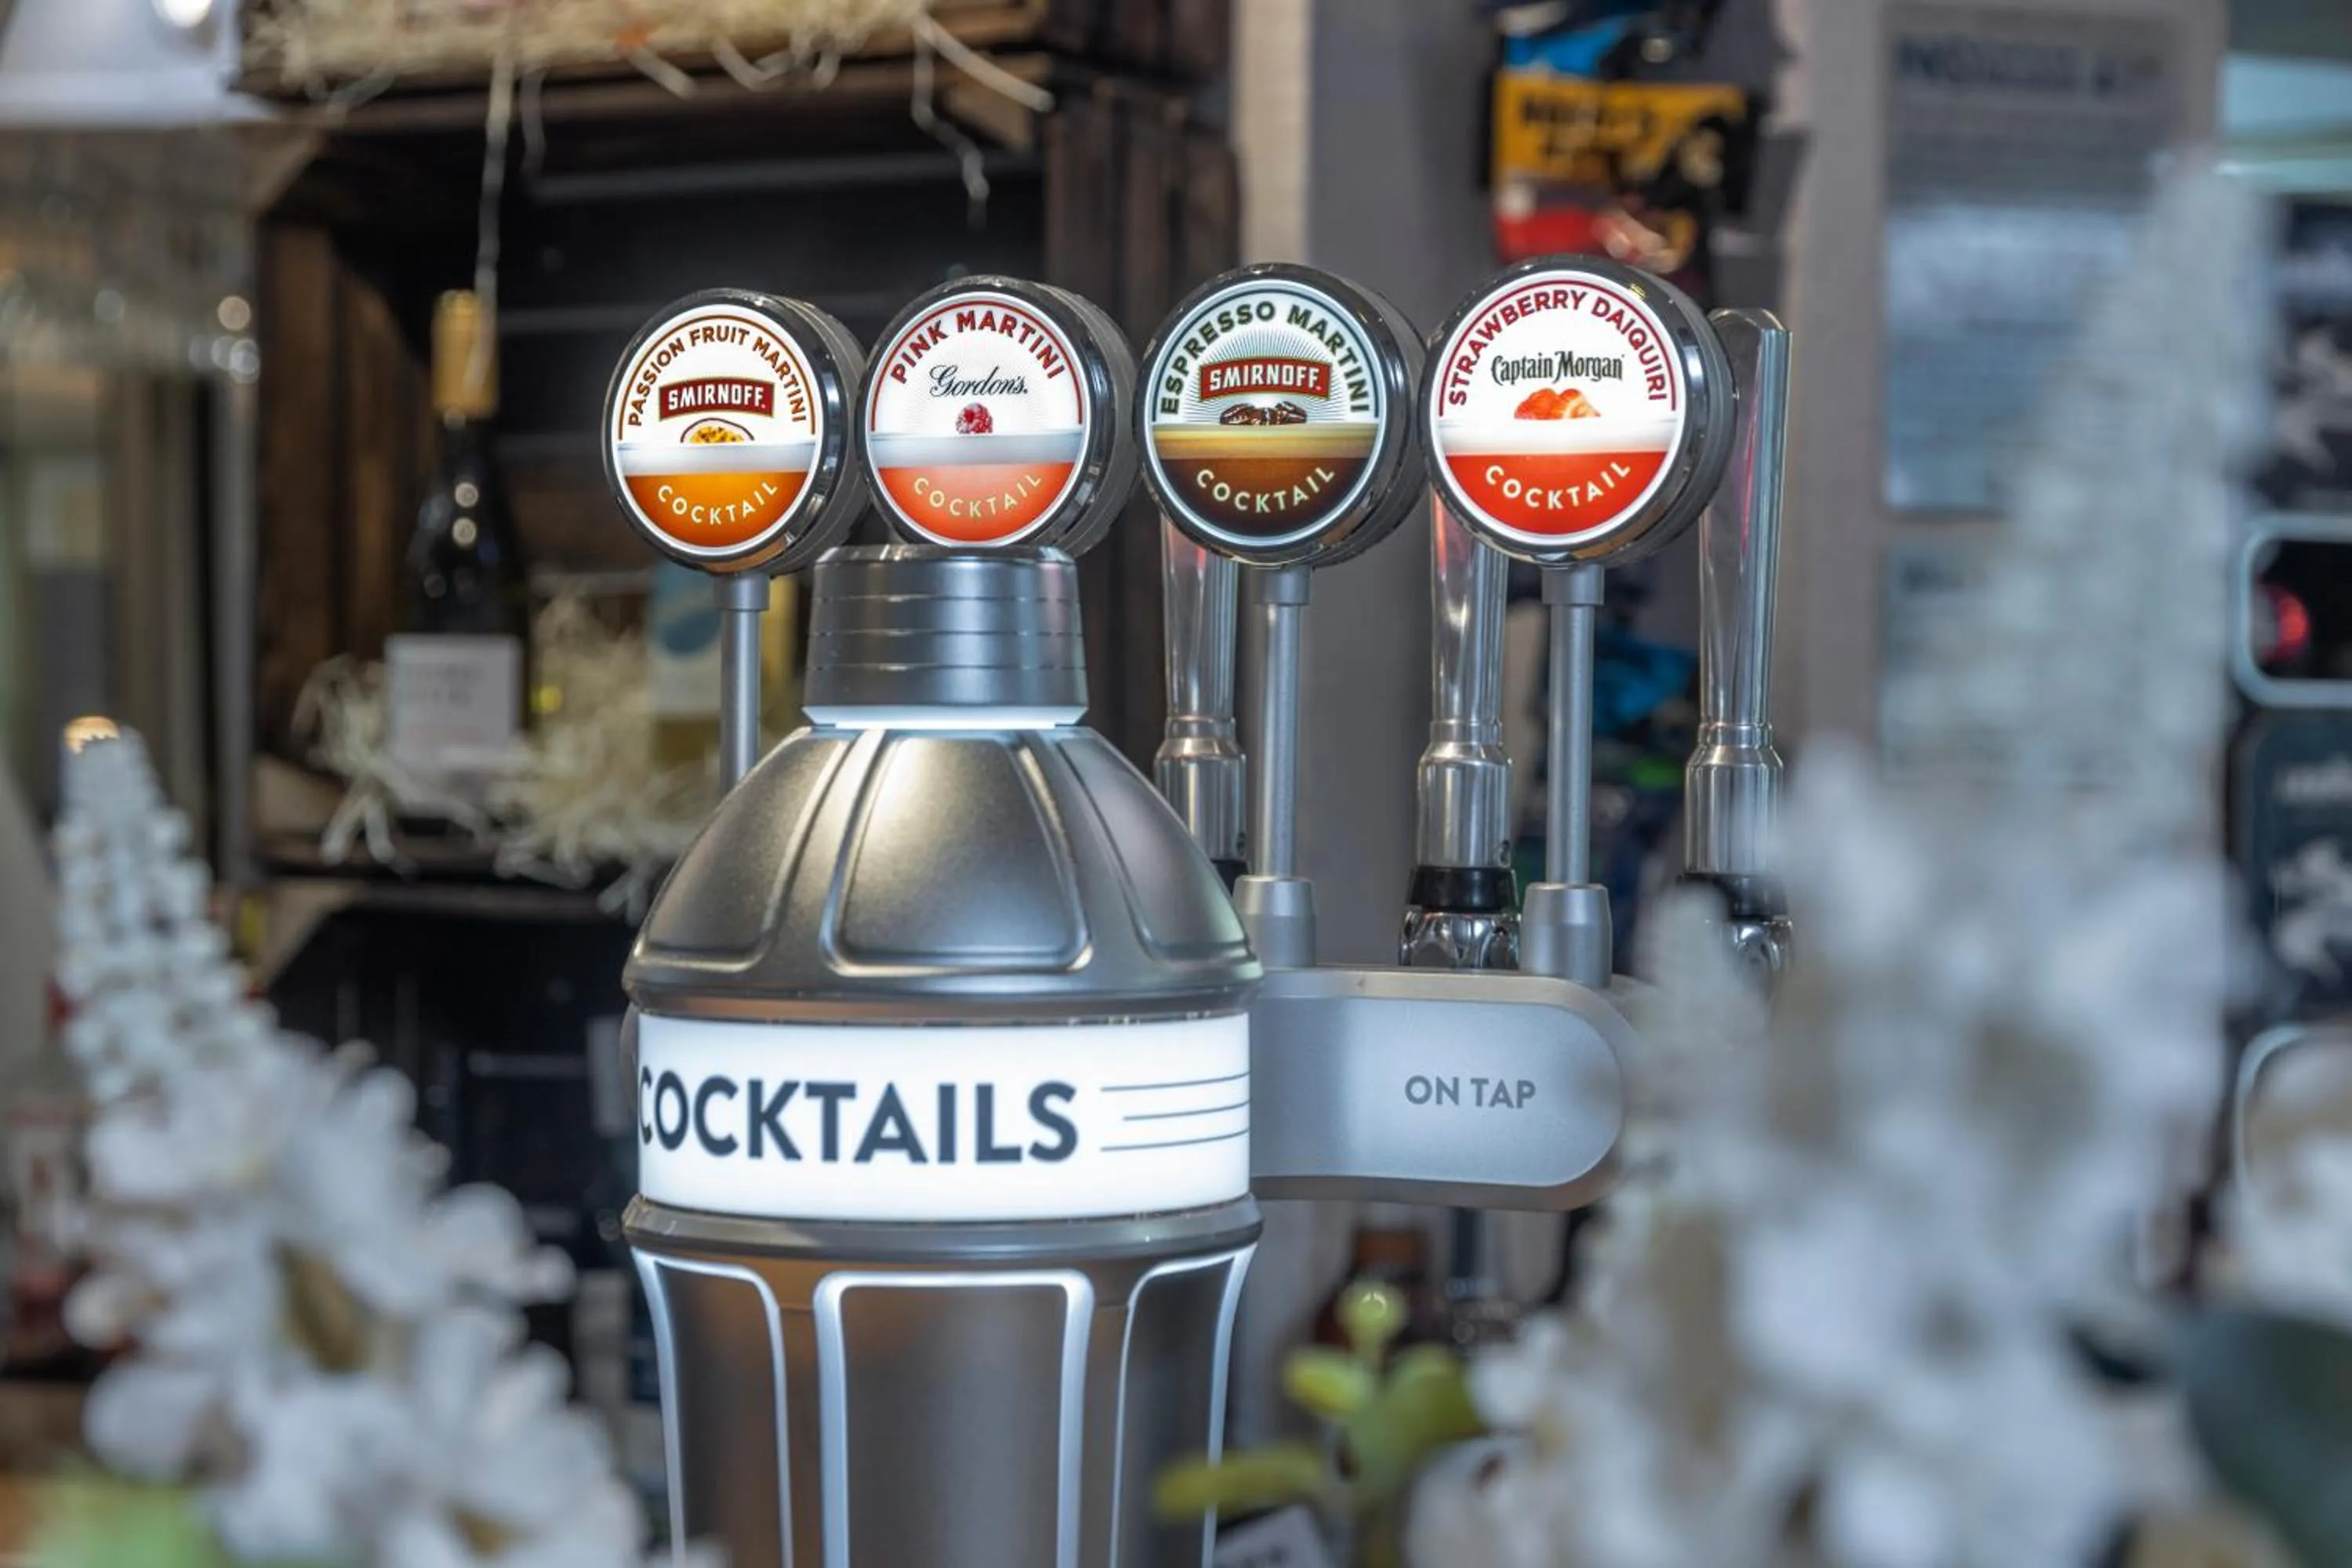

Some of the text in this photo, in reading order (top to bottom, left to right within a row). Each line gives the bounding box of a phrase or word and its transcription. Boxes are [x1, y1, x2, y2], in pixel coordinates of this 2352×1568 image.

[891, 310, 1065, 383] PINK MARTINI
[1160, 301, 1370, 415] ESPRESSO MARTINI
[1448, 289, 1668, 406] STRAWBERRY DAIQUIRI
[1490, 350, 1623, 386] Captain Morgan
[627, 325, 807, 426] PASSION FRUIT MARTINI
[657, 481, 778, 525] COCKTAIL
[913, 474, 1043, 518] COCKTAIL
[1196, 467, 1335, 513] COCKTAIL
[1485, 461, 1631, 510] COCKTAIL
[1405, 1074, 1537, 1109] ON TAP
